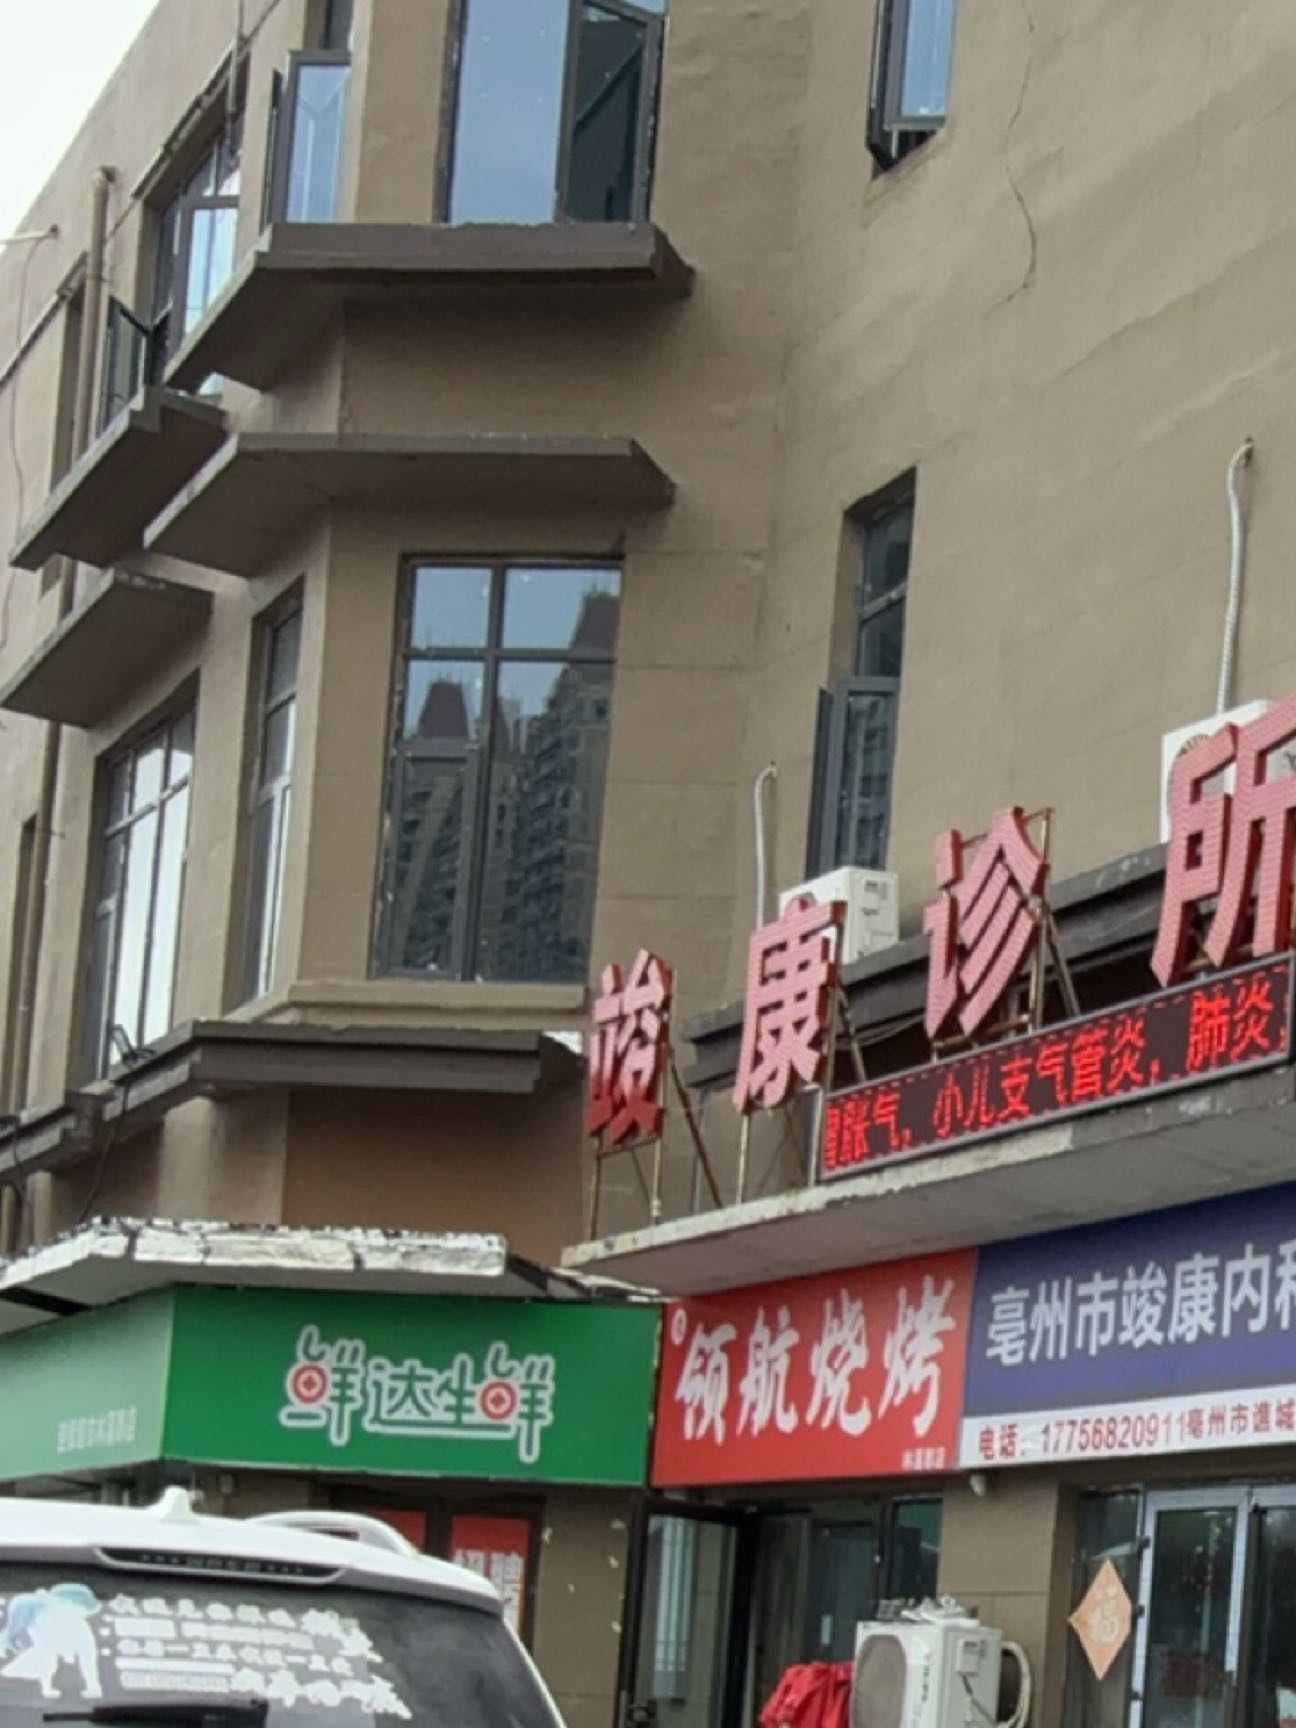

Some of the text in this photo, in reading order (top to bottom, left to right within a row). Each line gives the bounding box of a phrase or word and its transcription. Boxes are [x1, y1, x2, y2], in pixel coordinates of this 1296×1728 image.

[279, 1324, 554, 1462] 鲜达生鲜
[675, 1274, 957, 1446] 领航烧烤
